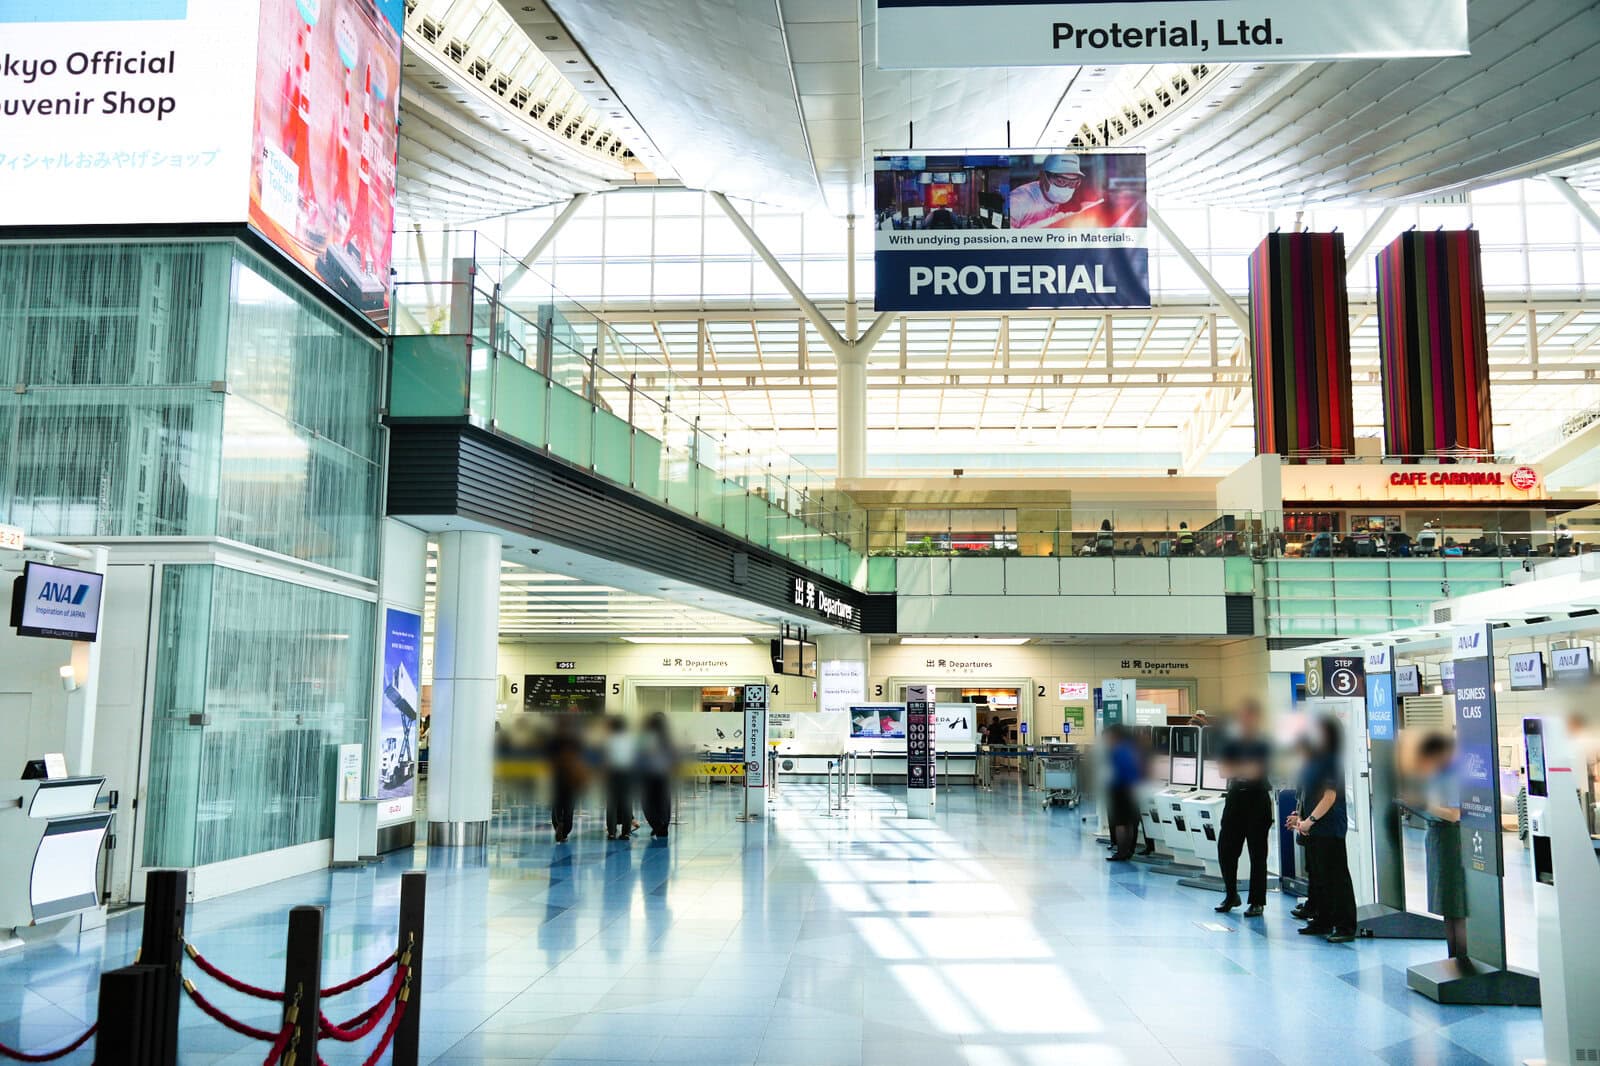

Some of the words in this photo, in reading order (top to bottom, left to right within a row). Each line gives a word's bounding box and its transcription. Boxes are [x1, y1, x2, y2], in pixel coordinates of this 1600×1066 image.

[1052, 20, 1209, 52] Proterial,
[1217, 17, 1284, 47] Ltd.
[0, 53, 57, 84] kyo
[66, 50, 175, 75] Official
[0, 91, 95, 116] uvenir
[102, 91, 176, 121] Shop
[889, 234, 914, 245] With
[917, 234, 960, 247] undying
[963, 234, 1008, 246] passion,
[1011, 235, 1018, 243] a
[1020, 235, 1043, 243] new
[1046, 233, 1065, 243] Pro
[1068, 233, 1077, 243] in
[1080, 232, 1134, 242] Materials.
[909, 264, 1116, 296] PROTERIAL
[1390, 472, 1427, 485] CAFE
[1430, 472, 1504, 485] CARDINAL
[38, 581, 72, 604] ANA
[794, 578, 815, 608] 出発
[36, 605, 63, 616] Inspiration
[1458, 635, 1473, 649] ANA
[663, 658, 682, 667] 出発
[685, 659, 729, 668] Departures
[926, 659, 947, 668] 出発
[949, 660, 993, 669] Departures
[1121, 660, 1142, 669] 出発
[1144, 661, 1189, 670] Departures
[1514, 661, 1528, 672] ANA
[1559, 655, 1573, 666] ANA
[1310, 671, 1317, 690] 3
[1338, 672, 1351, 691] 3
[511, 683, 518, 694] 6
[612, 683, 620, 695] 5
[771, 684, 779, 696] 4
[875, 684, 883, 696] 3
[1038, 685, 1046, 697] 2
[1457, 688, 1486, 700] BUSINESS
[1462, 706, 1482, 719] CLASS
[751, 711, 759, 728] Face
[750, 729, 758, 757] Express
